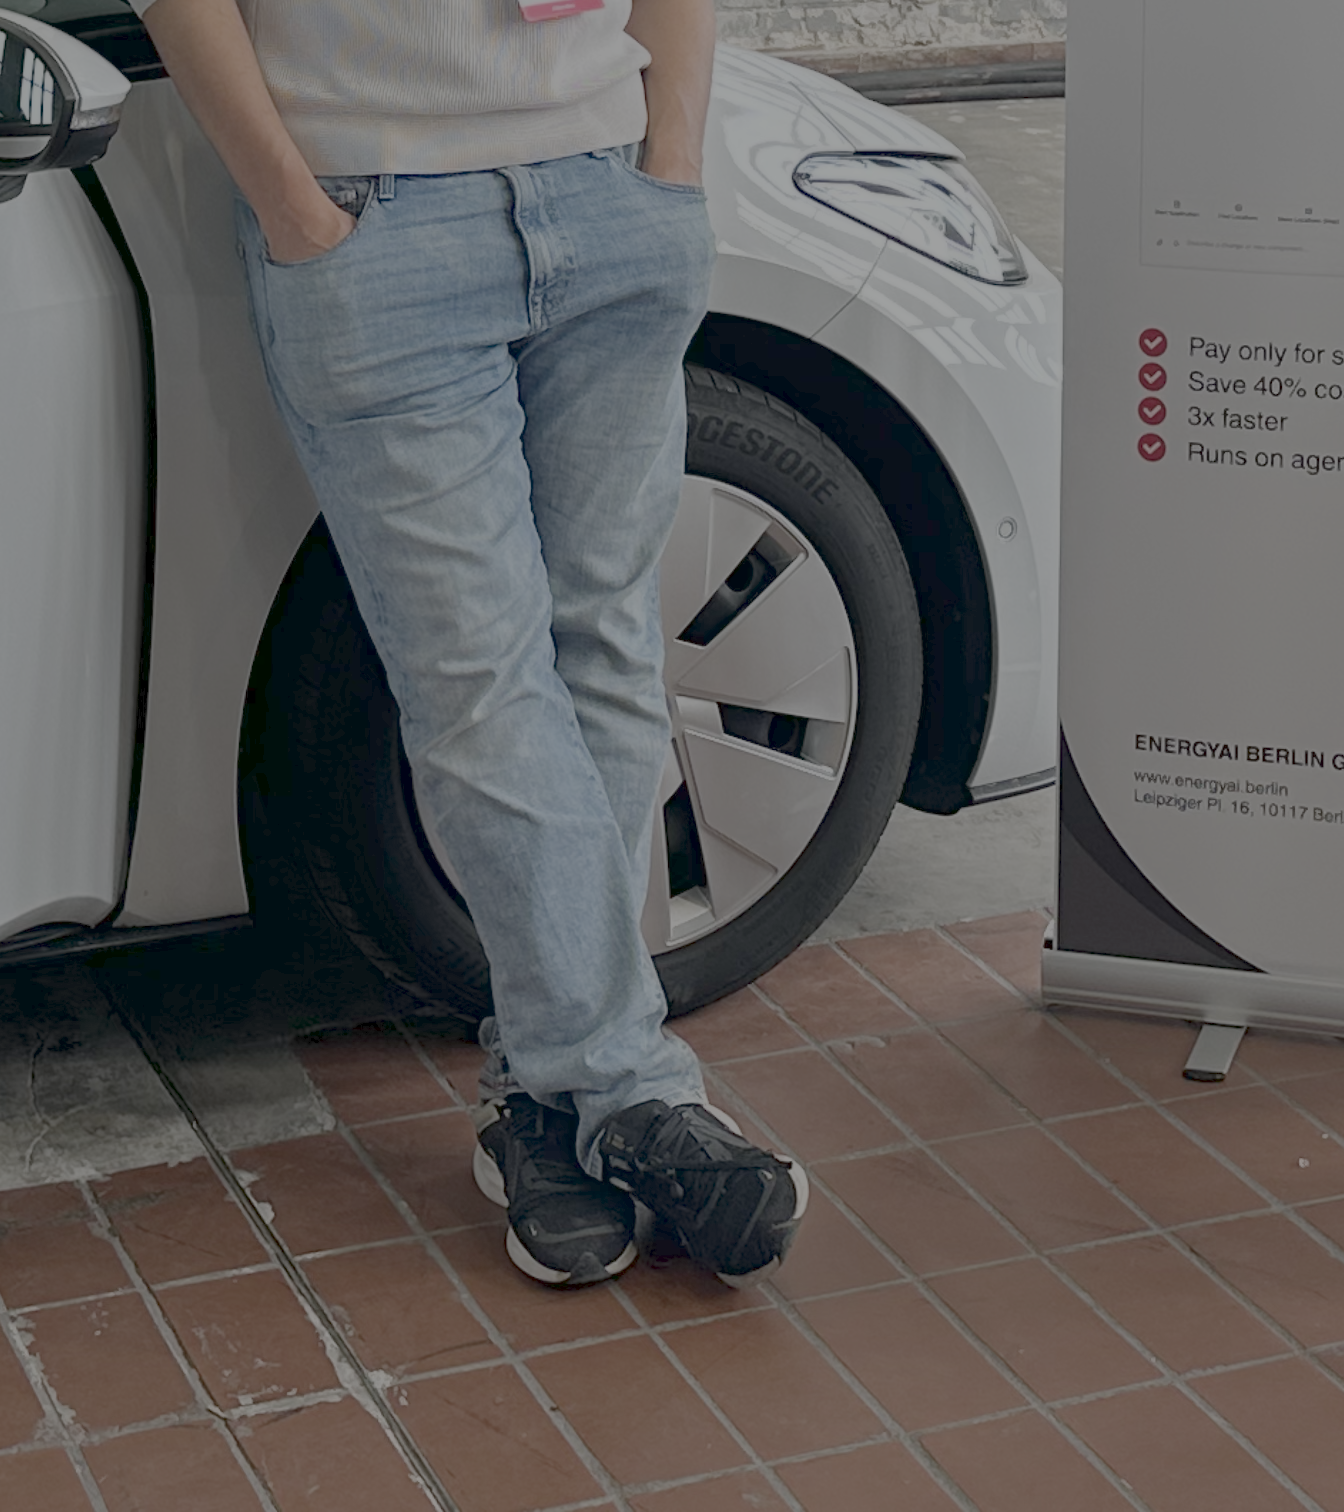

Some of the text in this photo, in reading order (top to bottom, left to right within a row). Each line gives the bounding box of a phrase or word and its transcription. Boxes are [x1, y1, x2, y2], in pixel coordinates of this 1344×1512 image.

[1190, 337, 1231, 364] Pay
[1239, 343, 1286, 367] only
[1295, 343, 1325, 363] for
[1189, 371, 1245, 394] Save
[1254, 377, 1306, 397] 40%
[1188, 407, 1287, 431] 3x faster
[1189, 442, 1247, 465] Runs
[1255, 452, 1283, 467] on
[1136, 735, 1238, 760] ENERGYAI
[1247, 746, 1324, 767] BERLIN
[1134, 772, 1288, 799] www.energyai.berlin
[1135, 789, 1202, 811] Leipziger
[1232, 801, 1253, 816] 16,
[1260, 803, 1308, 819] 10117
